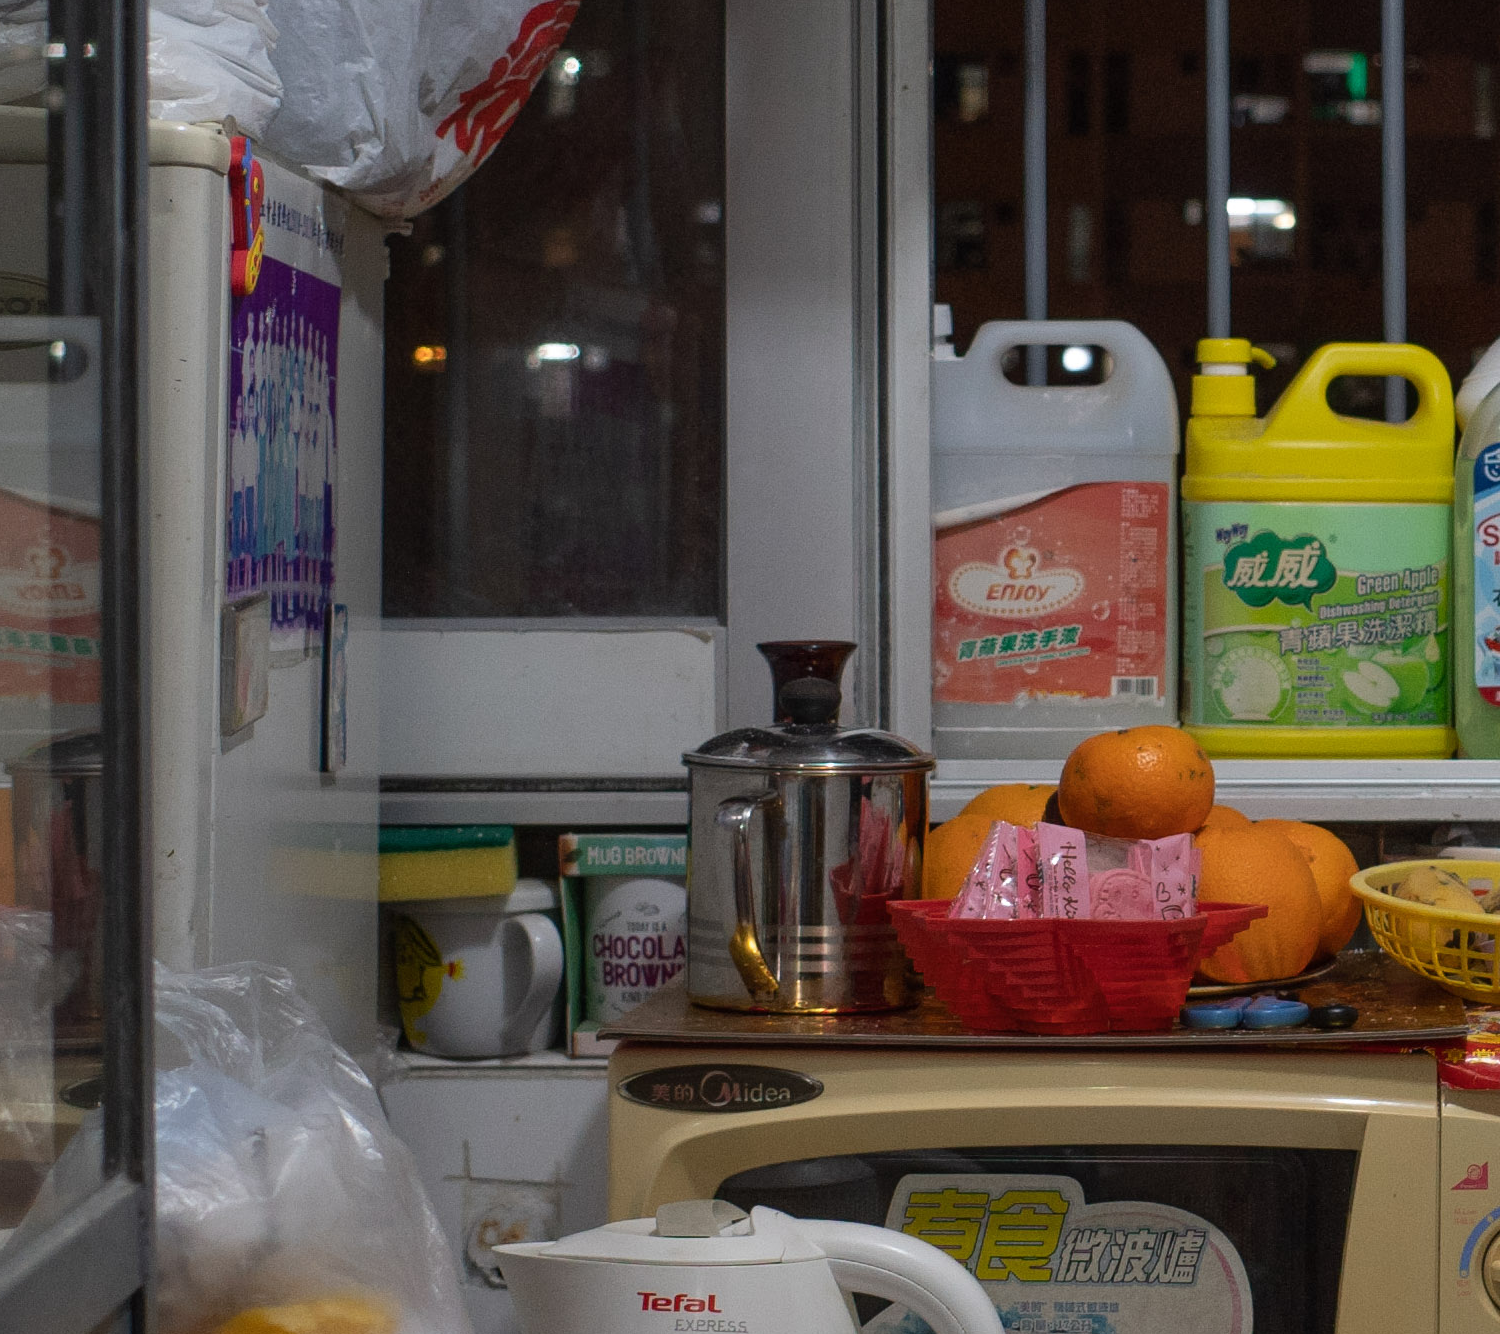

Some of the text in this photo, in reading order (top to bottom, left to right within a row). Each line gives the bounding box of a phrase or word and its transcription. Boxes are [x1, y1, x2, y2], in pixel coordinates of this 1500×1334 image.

[1227, 540, 1321, 588] 威威
[1357, 565, 1439, 596] Green Apple
[1318, 591, 1439, 620] Dishwashing Detergent
[1279, 609, 1438, 655] 青蘋果洗潔精
[587, 846, 622, 866] MUG
[1060, 841, 1078, 894] Hello
[602, 961, 685, 987] BROWN
[649, 1069, 792, 1107] 美的 Midea
[636, 1291, 723, 1314] Tefal
[674, 1318, 749, 1334] EXPRESS
